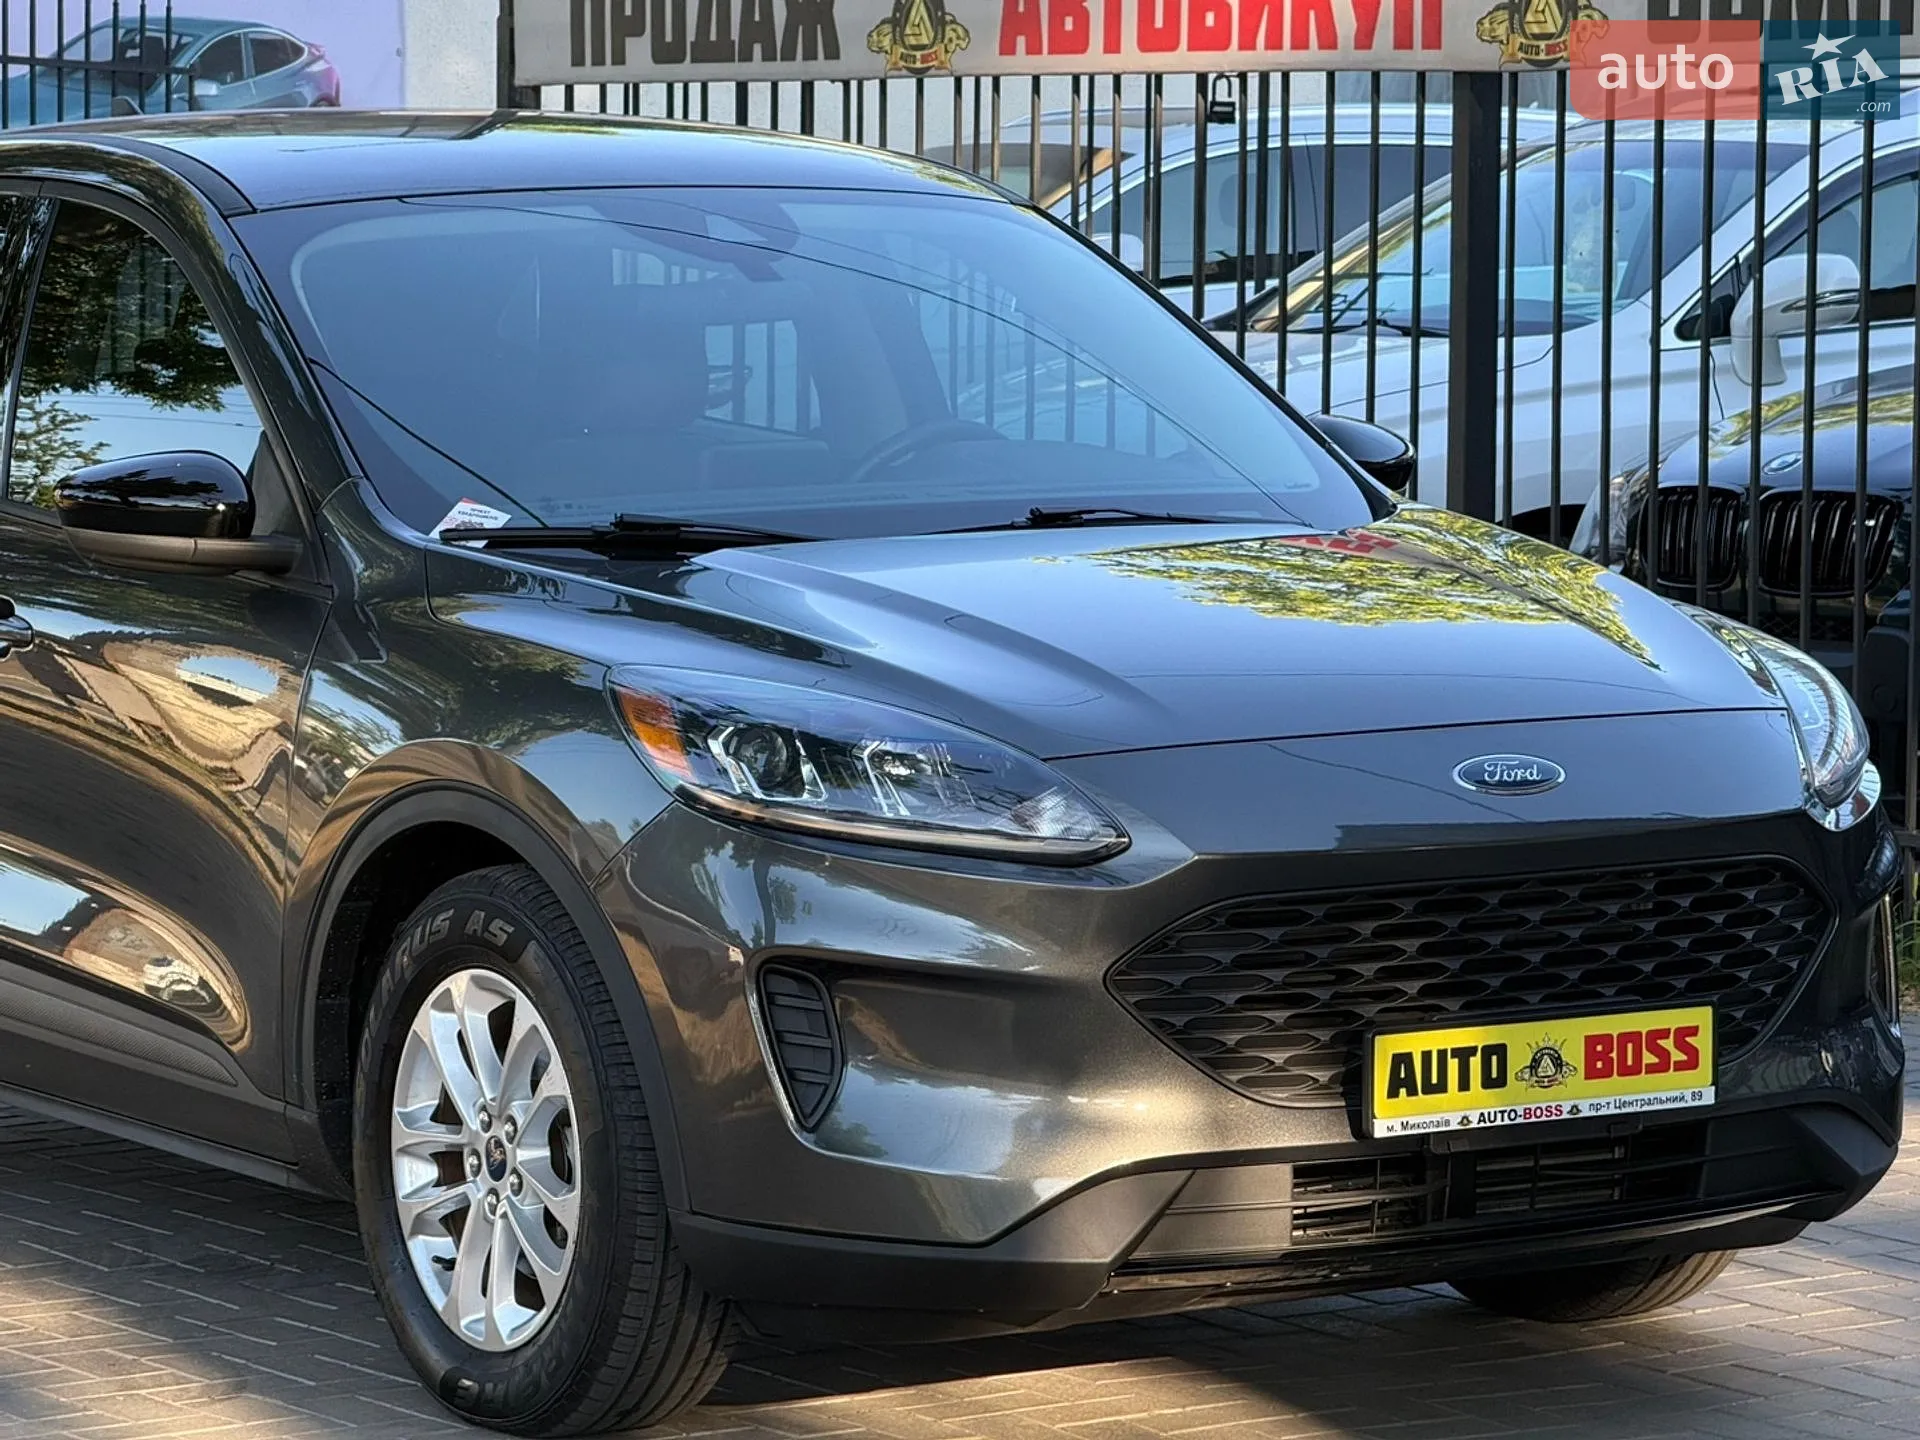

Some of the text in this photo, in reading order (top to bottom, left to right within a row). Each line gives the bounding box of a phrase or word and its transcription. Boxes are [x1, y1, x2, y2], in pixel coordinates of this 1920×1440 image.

[571, 0, 1443, 67] ПРОДАЖ АВТОВИКУП
[1484, 760, 1542, 782] Ford
[464, 909, 515, 947] AS
[1386, 1025, 1700, 1099] AUTO BOSS
[1588, 1090, 1703, 1113] пр-т Центральний, 89
[1386, 1116, 1451, 1133] м. Миколаїв
[1477, 1104, 1563, 1125] AUTO-BOSS
